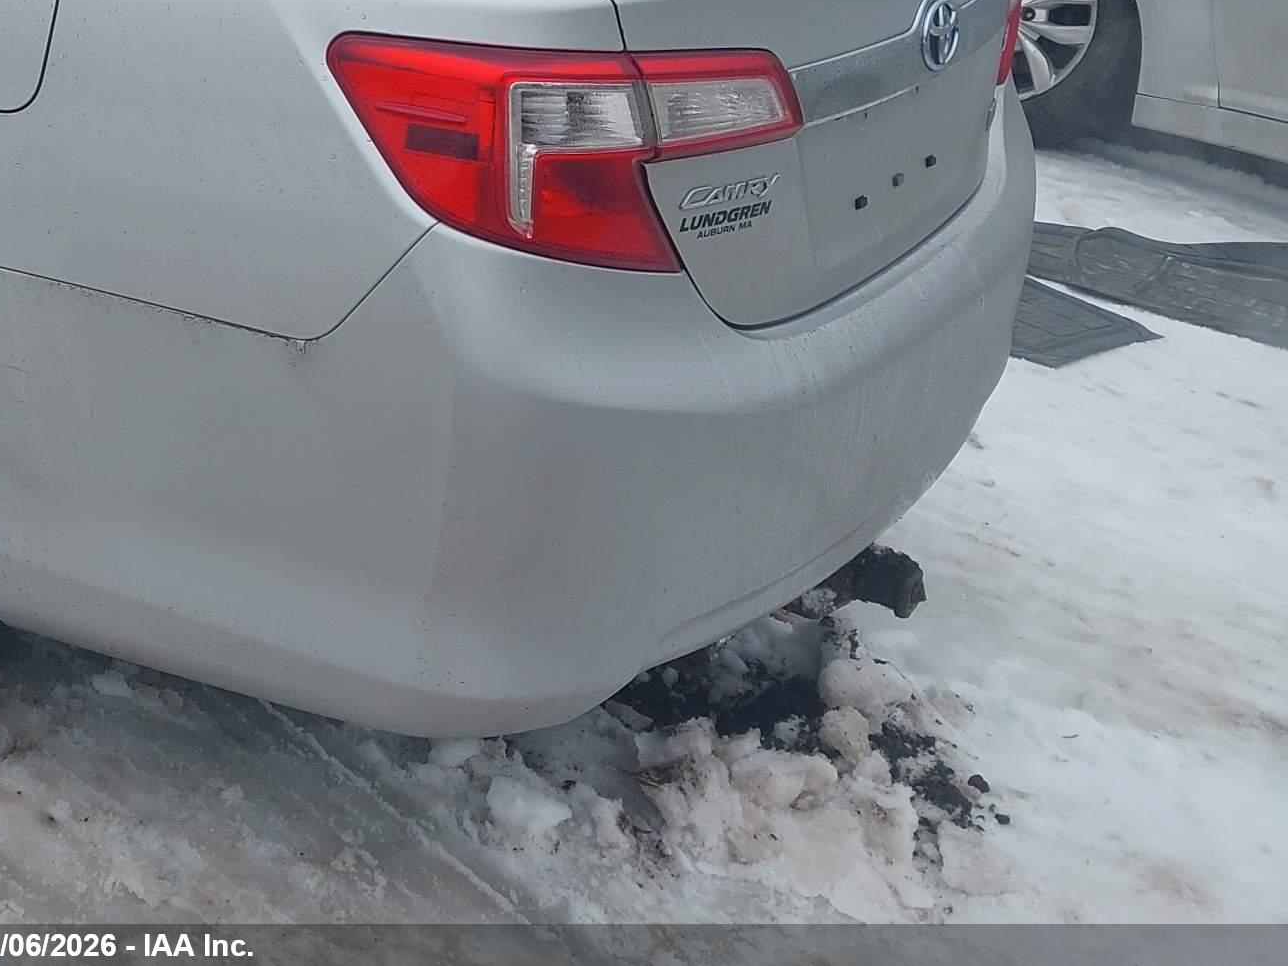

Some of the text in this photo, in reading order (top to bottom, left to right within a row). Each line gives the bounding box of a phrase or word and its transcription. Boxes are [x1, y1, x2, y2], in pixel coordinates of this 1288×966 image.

[679, 174, 781, 211] CAMRY
[679, 200, 772, 233] LUNDGREN
[696, 220, 753, 240] AUBURN MA
